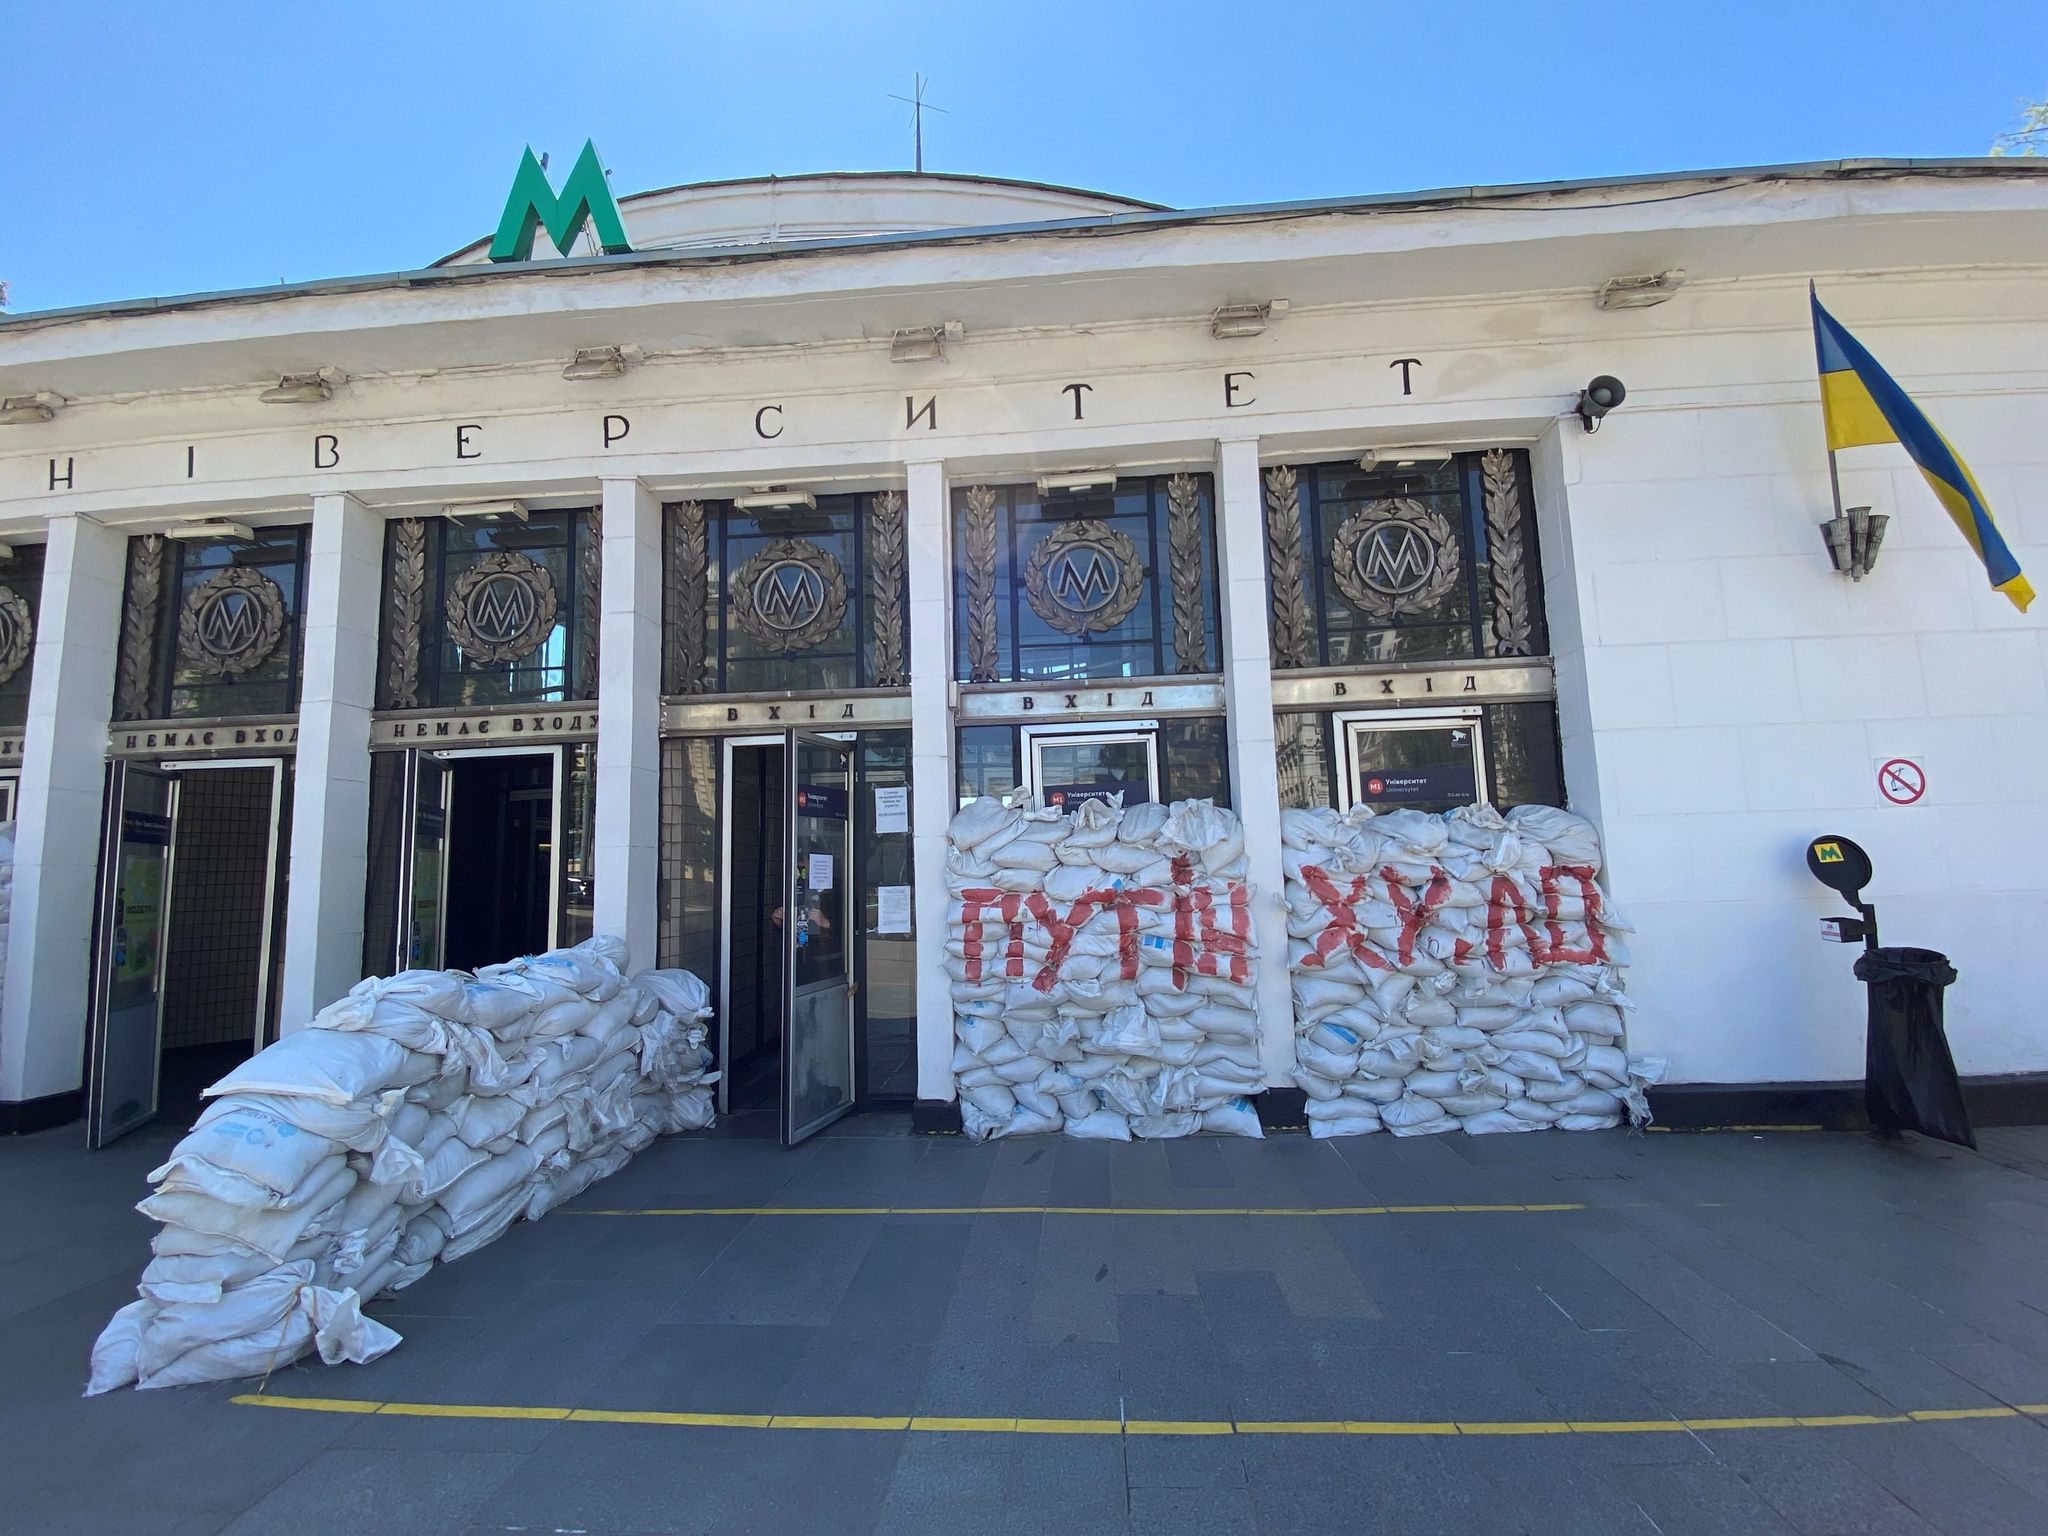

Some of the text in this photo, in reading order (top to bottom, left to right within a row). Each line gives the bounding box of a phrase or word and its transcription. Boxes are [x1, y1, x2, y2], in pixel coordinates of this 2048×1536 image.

[488, 137, 634, 263] М
[1333, 674, 1477, 697] ВХІД
[1021, 690, 1154, 710] ВХІД
[726, 703, 854, 722] ВХІД
[393, 720, 489, 738] НЕМАЄ
[126, 733, 213, 749] НЕМАЄ
[1385, 778, 1427, 786] Університет
